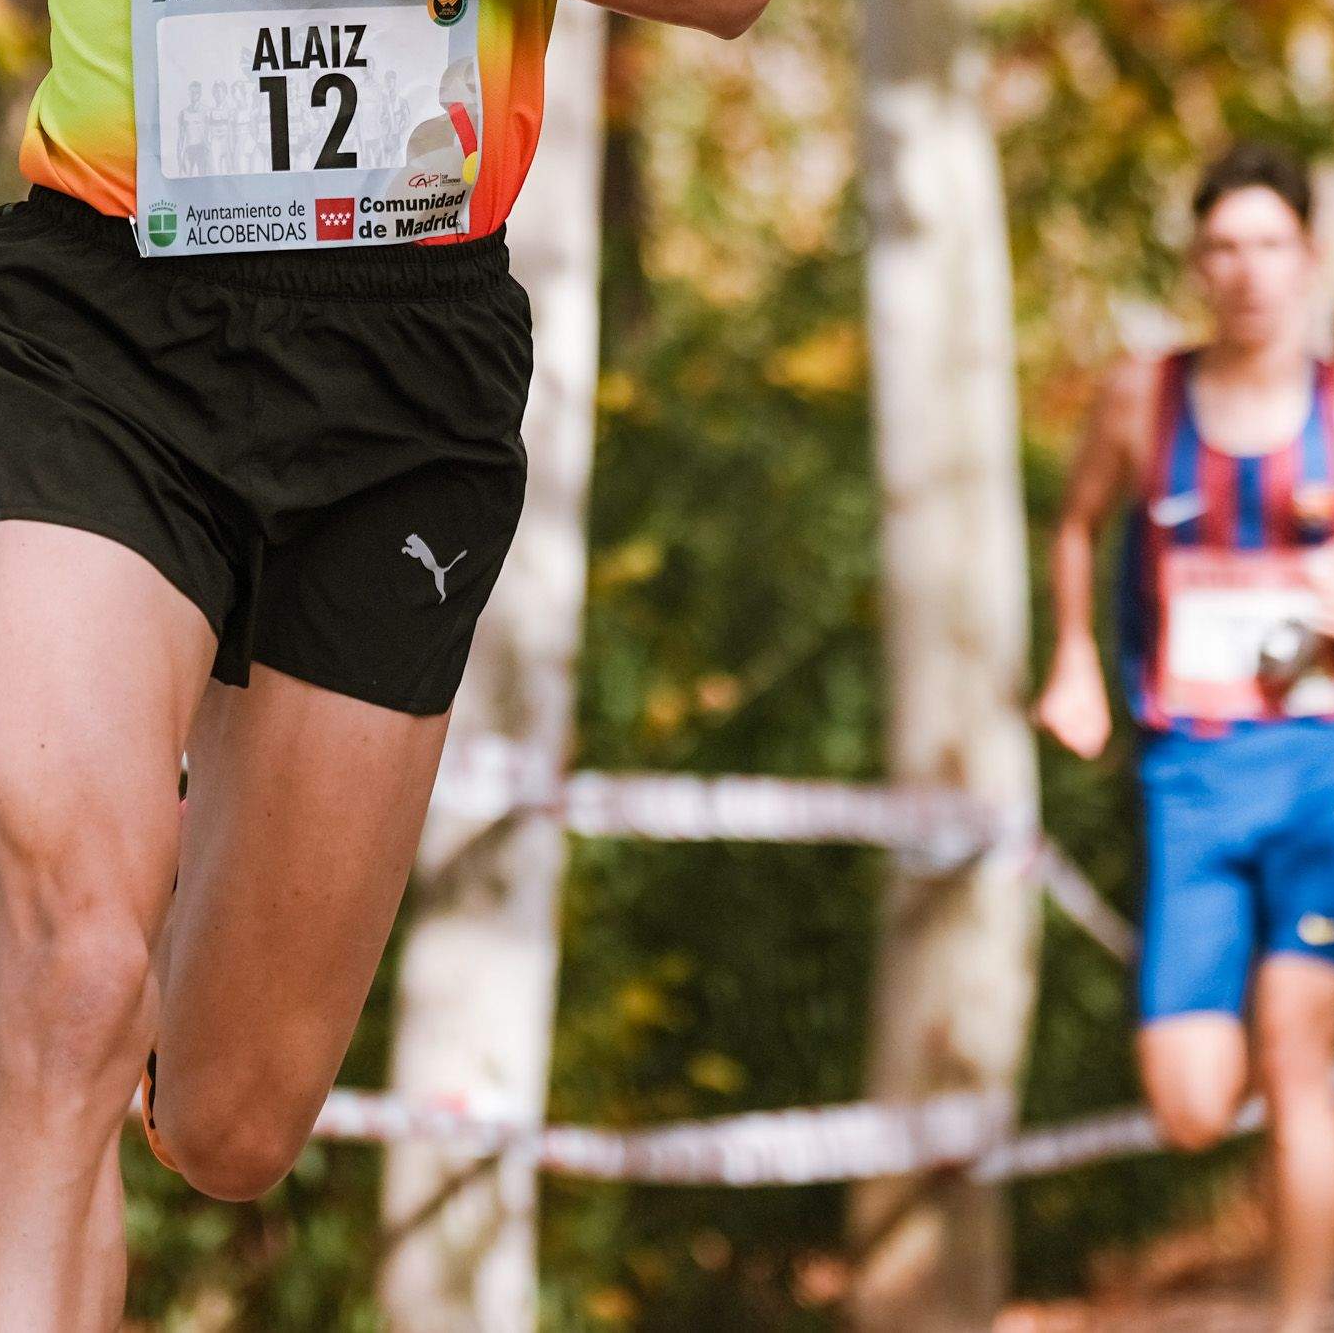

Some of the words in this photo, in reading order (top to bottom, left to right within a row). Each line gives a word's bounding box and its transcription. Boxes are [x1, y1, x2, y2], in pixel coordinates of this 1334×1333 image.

[252, 24, 367, 71] ALAIZ
[259, 72, 359, 172] 12
[185, 203, 282, 227] Ayuntamiento
[288, 199, 305, 216] de
[359, 189, 466, 214] Comunidad
[185, 221, 307, 247] ALCOBENDAS
[358, 220, 387, 239] de
[395, 210, 459, 238] Madrid
